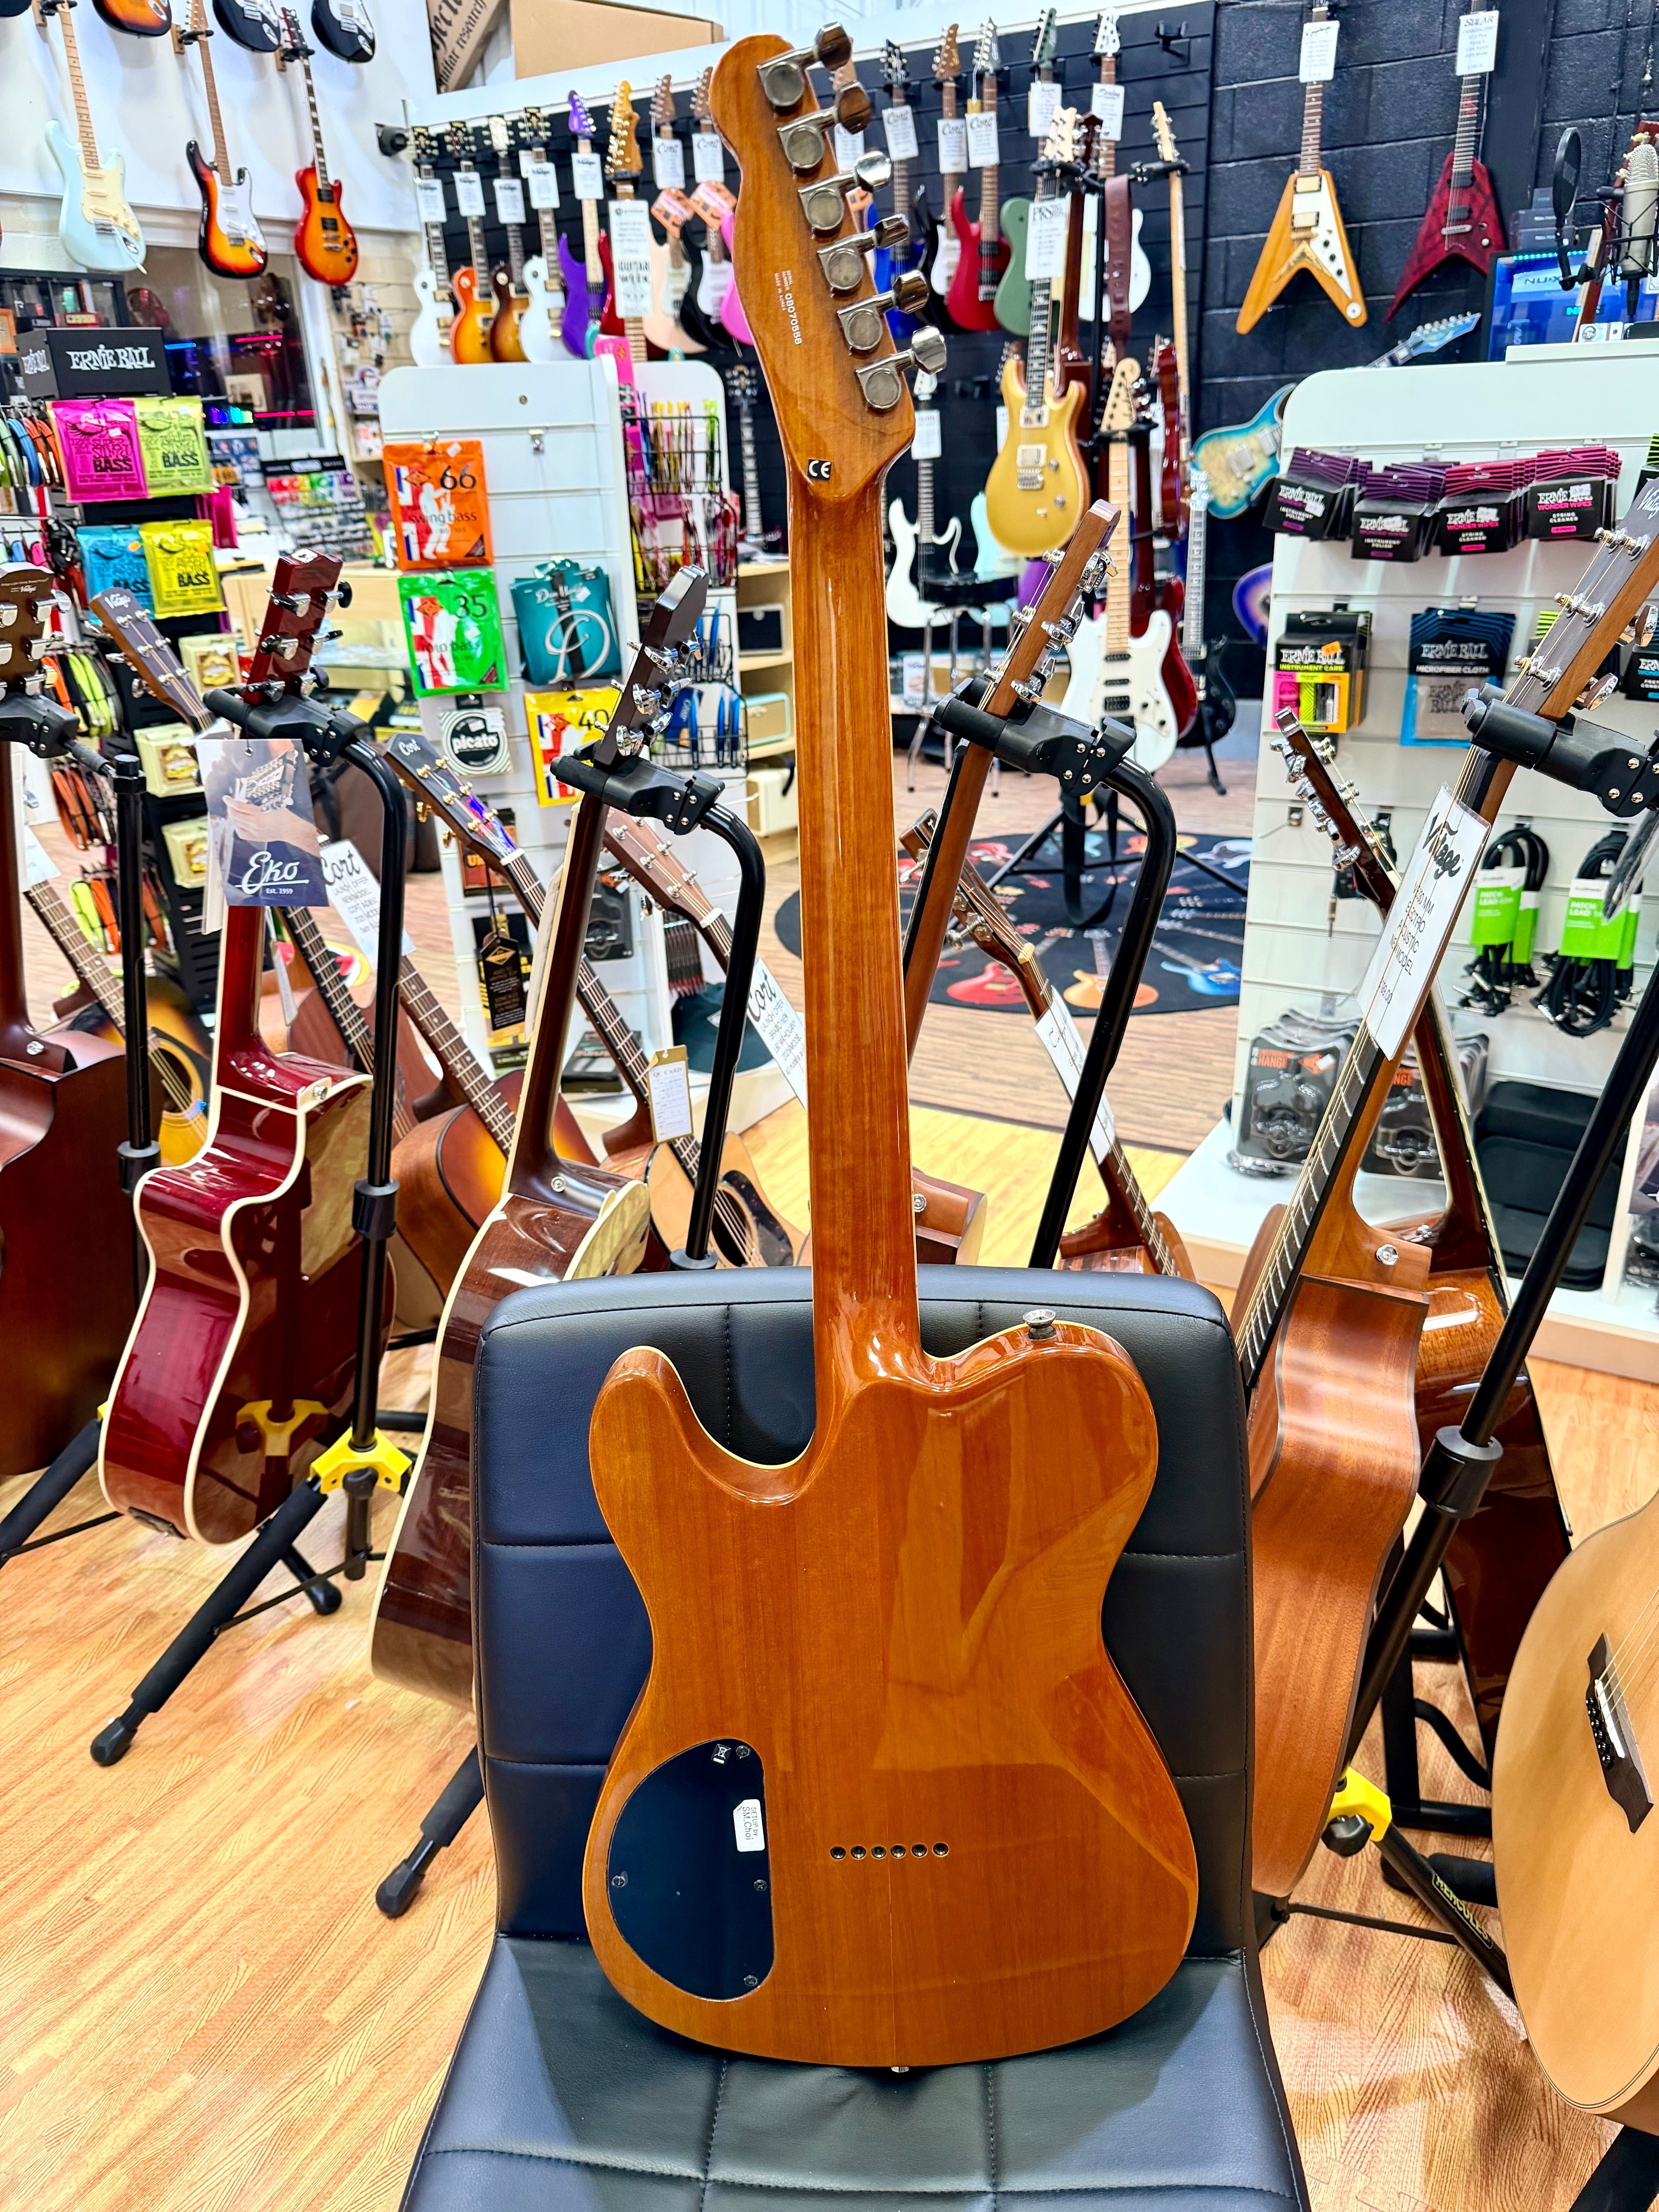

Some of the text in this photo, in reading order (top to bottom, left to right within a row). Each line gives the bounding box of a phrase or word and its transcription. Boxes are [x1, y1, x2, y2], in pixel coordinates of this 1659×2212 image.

[66, 344, 155, 370] ERNIE BALL
[93, 458, 132, 472] BASS
[163, 453, 199, 467] BASS
[809, 460, 831, 478] CE
[440, 464, 476, 490] 66
[1279, 484, 1305, 502] ERNIE
[1537, 488, 1570, 503] ERNIE
[448, 510, 477, 522] bass
[1360, 516, 1384, 529] ERNI
[1446, 508, 1476, 525] ERNIE
[178, 573, 210, 587] BASS
[454, 594, 486, 618] 35
[1280, 646, 1316, 664] ERNIE
[1420, 640, 1489, 659] ERNIE BALL
[1416, 665, 1490, 674] MICROFIBER CLOTH
[1638, 658, 1659, 671] ERN
[579, 709, 610, 730] 40
[452, 733, 498, 754] picato
[242, 851, 300, 895] Eko
[321, 850, 360, 886] Cort
[1423, 897, 1434, 915] MM
[1395, 946, 1413, 976] MODEL
[773, 999, 784, 1016] OFFER
[780, 1019, 796, 1047] MAHOGANY
[1259, 1057, 1288, 1069] HANGE
[742, 1807, 753, 1839] SM.Choi
[1434, 1875, 1490, 1941] HERCULES
